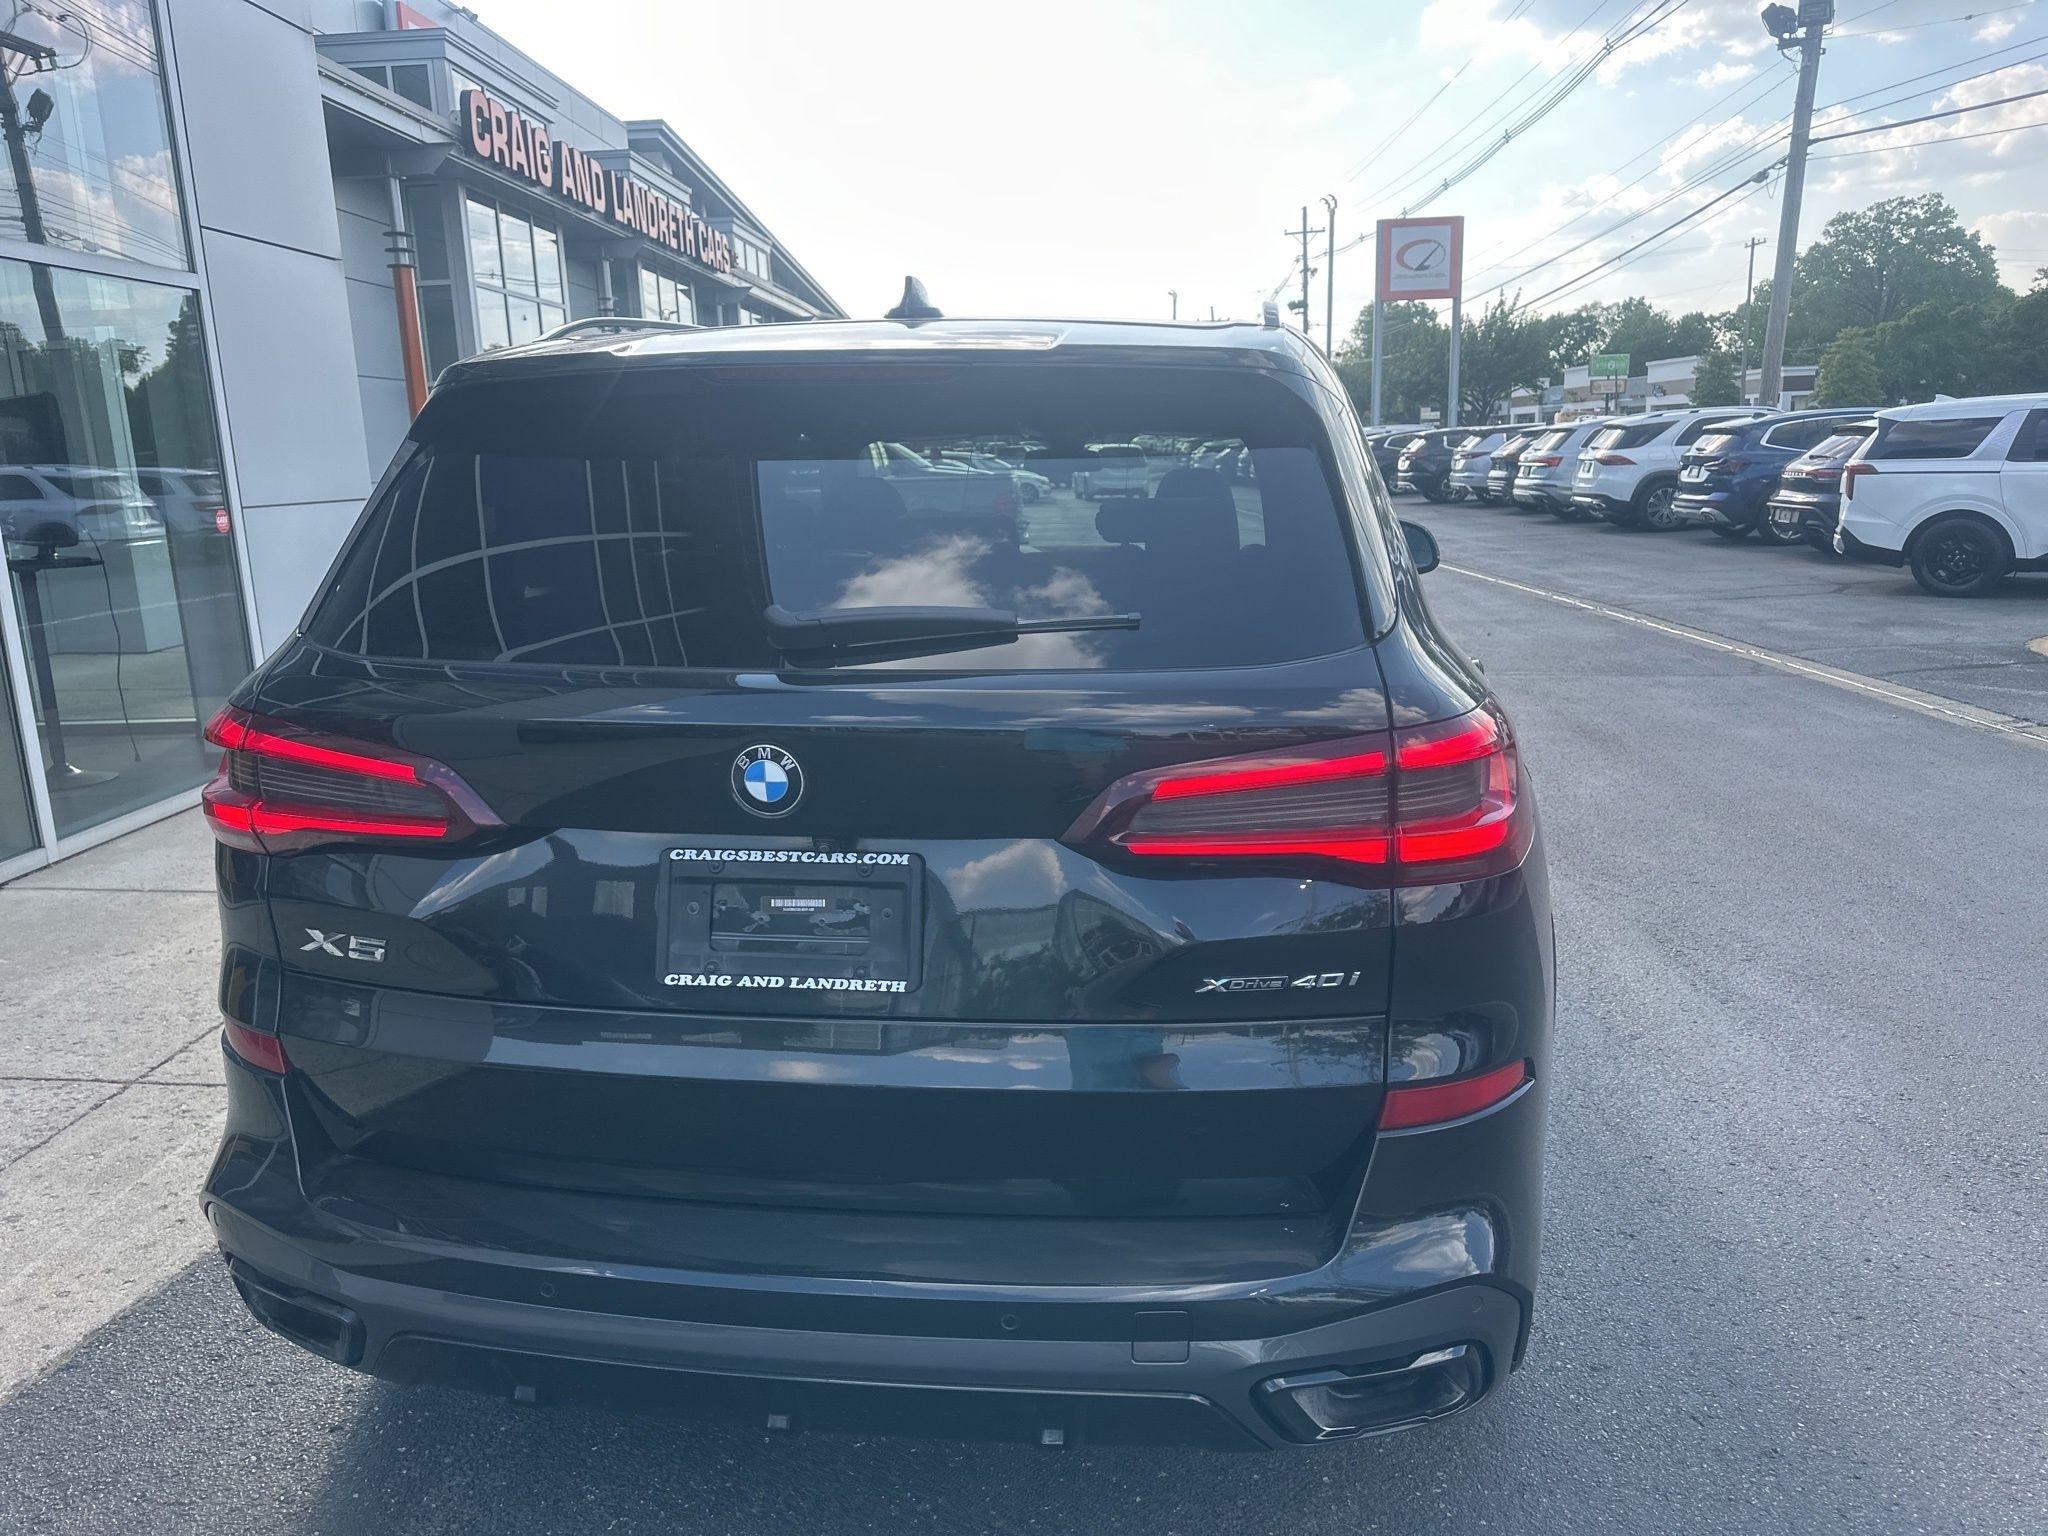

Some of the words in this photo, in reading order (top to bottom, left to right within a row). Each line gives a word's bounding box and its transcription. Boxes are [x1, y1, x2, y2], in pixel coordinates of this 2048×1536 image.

[468, 89, 552, 188] CRAIG
[560, 141, 606, 214] AND
[611, 170, 696, 258] LANDRETH
[698, 220, 731, 273] CARS
[737, 747, 796, 770] BMW
[669, 849, 910, 866] CRAIGSBESTCARS.COM
[299, 927, 387, 962] X5
[664, 974, 733, 987] CRAIG
[736, 976, 785, 988] AND
[788, 977, 908, 993] LANDRETH
[1290, 971, 1361, 989] 40i
